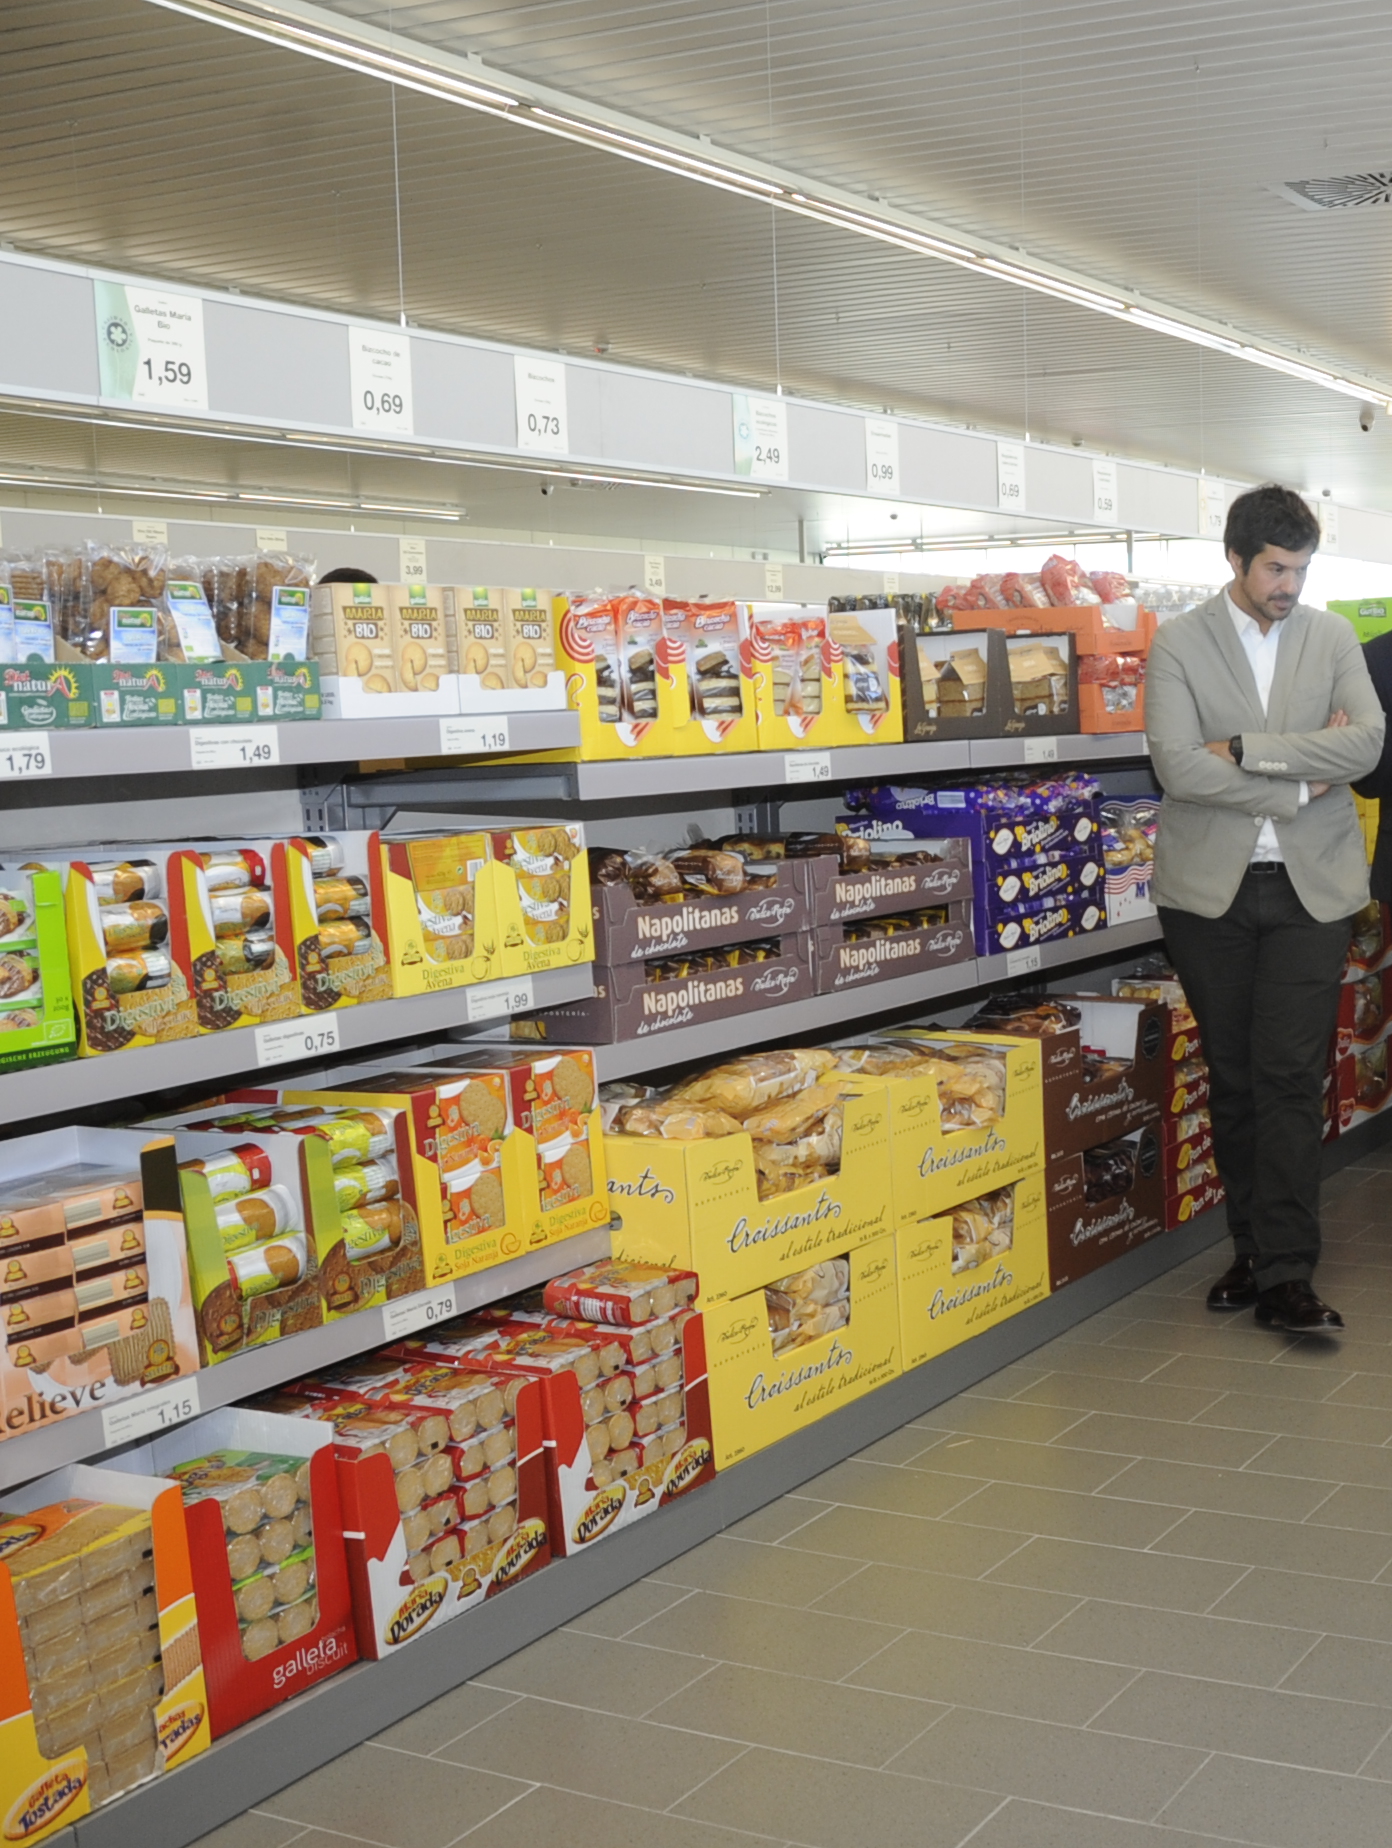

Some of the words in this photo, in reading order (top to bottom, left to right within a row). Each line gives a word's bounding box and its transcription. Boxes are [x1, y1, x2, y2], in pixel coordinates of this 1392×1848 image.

[143, 358, 192, 386] 1,59
[363, 390, 403, 415] 0,69
[527, 413, 560, 436] 0,73
[755, 445, 780, 466] 2,49
[871, 463, 894, 481] 0,99
[355, 623, 377, 638] BIO
[411, 624, 431, 638] BIO
[474, 624, 493, 638] BIO
[523, 624, 541, 638] BIO
[239, 744, 271, 764] 1,49
[481, 732, 506, 750] 1,19
[6, 752, 46, 774] 1,79
[1021, 819, 1058, 852] Briolino
[835, 874, 916, 905] Napolitanas
[1028, 864, 1064, 897] Briolino
[637, 905, 739, 940] Napolitanas
[830, 908, 841, 920] de
[841, 899, 876, 918] chocolate
[1029, 909, 1064, 942] Briolino
[523, 946, 561, 962] Digestiva
[631, 944, 643, 959] de
[644, 932, 689, 957] chocolate
[839, 938, 921, 969] Napolitanas
[422, 963, 465, 980] Digestiva
[525, 958, 551, 971] Avena
[834, 973, 845, 986] de
[845, 963, 880, 984] chocolate
[425, 976, 453, 990] Avena
[504, 993, 529, 1012] 1,99
[642, 977, 744, 1016] Napolitanas
[637, 1020, 650, 1035] de
[650, 1007, 694, 1032] chocolate
[304, 1031, 335, 1052] 0,75
[423, 1121, 480, 1157] Digestiva
[917, 1126, 1006, 1178] Croissants
[992, 1141, 1039, 1173] tradicional
[549, 1205, 587, 1227] Digestiva
[726, 1189, 842, 1253] Croissants
[825, 1204, 887, 1244] tradicional
[454, 1238, 497, 1260] Digestiva
[472, 1250, 499, 1265] Naranja
[927, 1261, 1013, 1321] Croissants
[426, 1299, 453, 1321] 0,79
[744, 1339, 853, 1410] Croissants
[836, 1346, 895, 1390] tradicional
[157, 1399, 192, 1425] 1,15
[577, 1497, 622, 1543] Dorada
[494, 1529, 548, 1585] Dourada
[388, 1588, 444, 1644] Dorada
[272, 1637, 337, 1689] galleta
[306, 1641, 348, 1676] biscuit
[158, 1710, 186, 1733] achas
[159, 1712, 202, 1750] radas
[18, 1776, 83, 1833] Tostada
